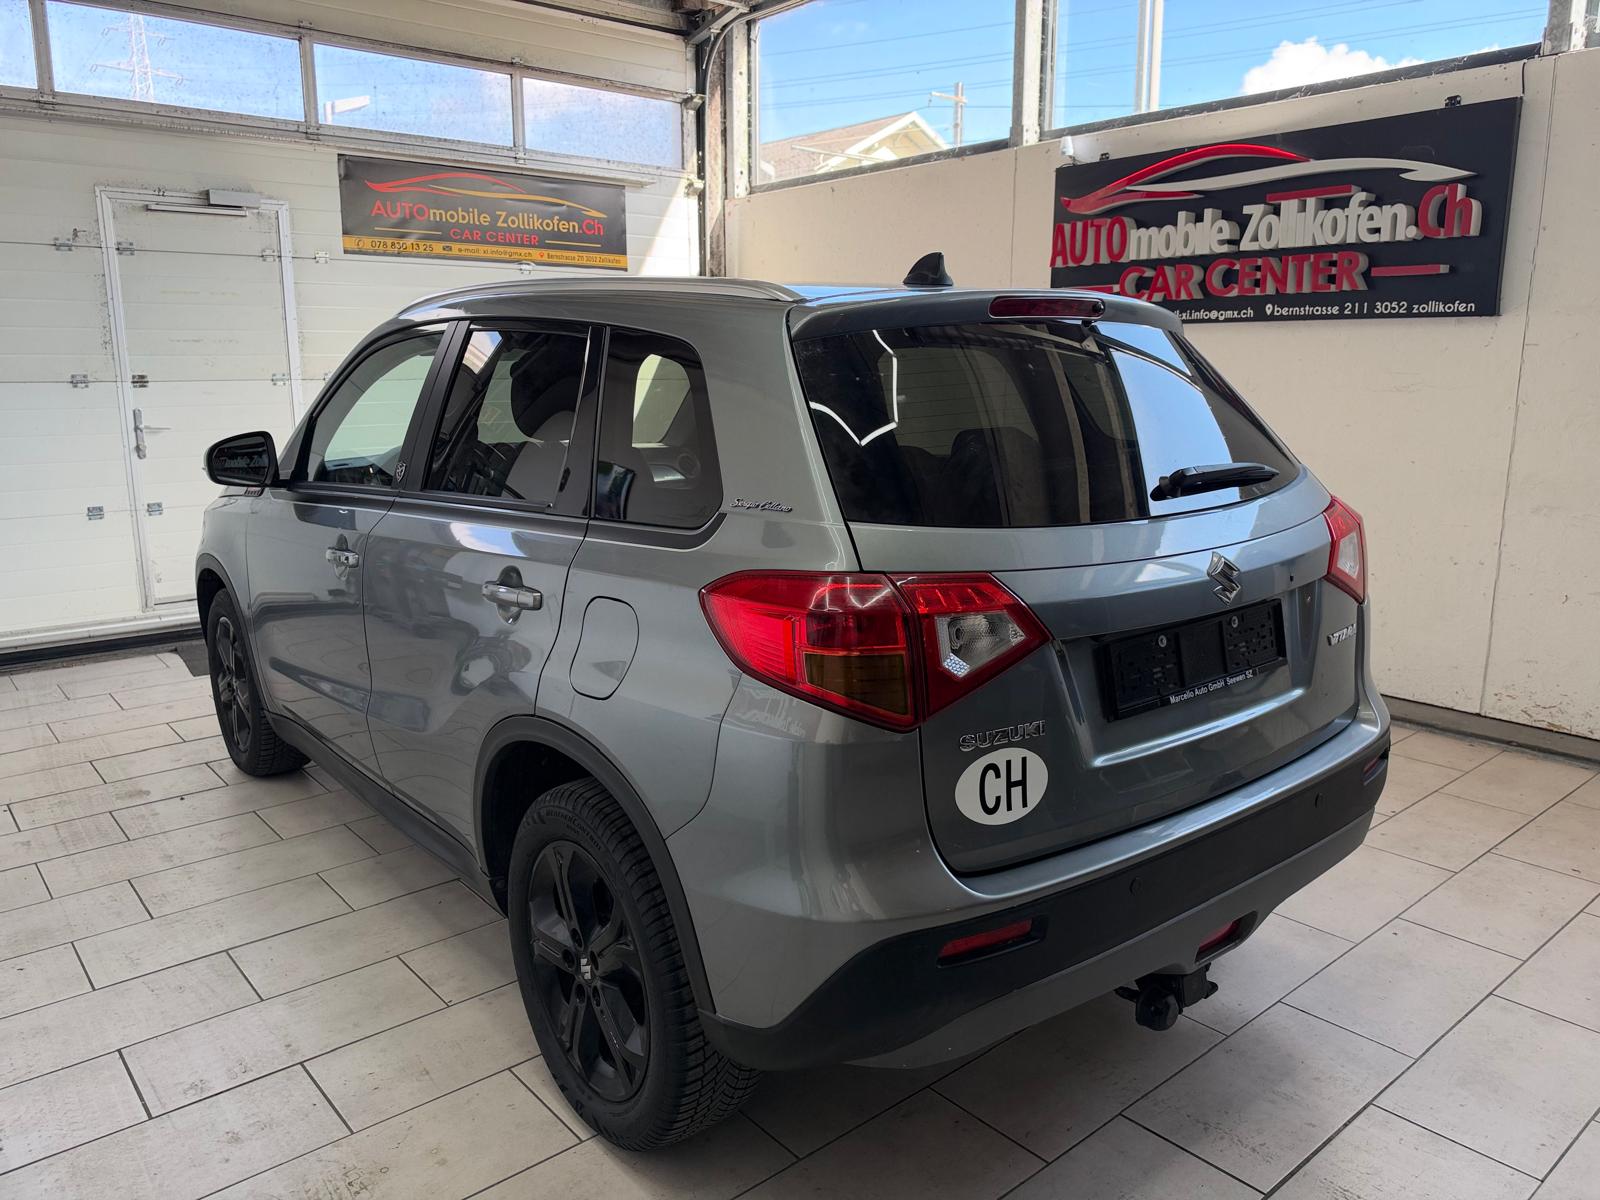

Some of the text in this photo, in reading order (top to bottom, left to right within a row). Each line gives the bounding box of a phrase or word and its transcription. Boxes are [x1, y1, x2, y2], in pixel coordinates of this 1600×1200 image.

[370, 199, 604, 237] AUTOmobile Zollikofen.Ch
[1050, 183, 1482, 268] AUTOmobile Zollikofen.Ch
[370, 240, 388, 249] 078
[411, 243, 420, 252] 13
[422, 243, 434, 252] 25
[449, 228, 539, 246] CAR CENTER
[1118, 250, 1369, 303] CAR CENTER
[1274, 300, 1475, 315] bernstrasse 211 3052 zollikofen
[1195, 686, 1208, 696] Auto
[959, 720, 1046, 752] SUZUKI
[979, 756, 1028, 816] CH
